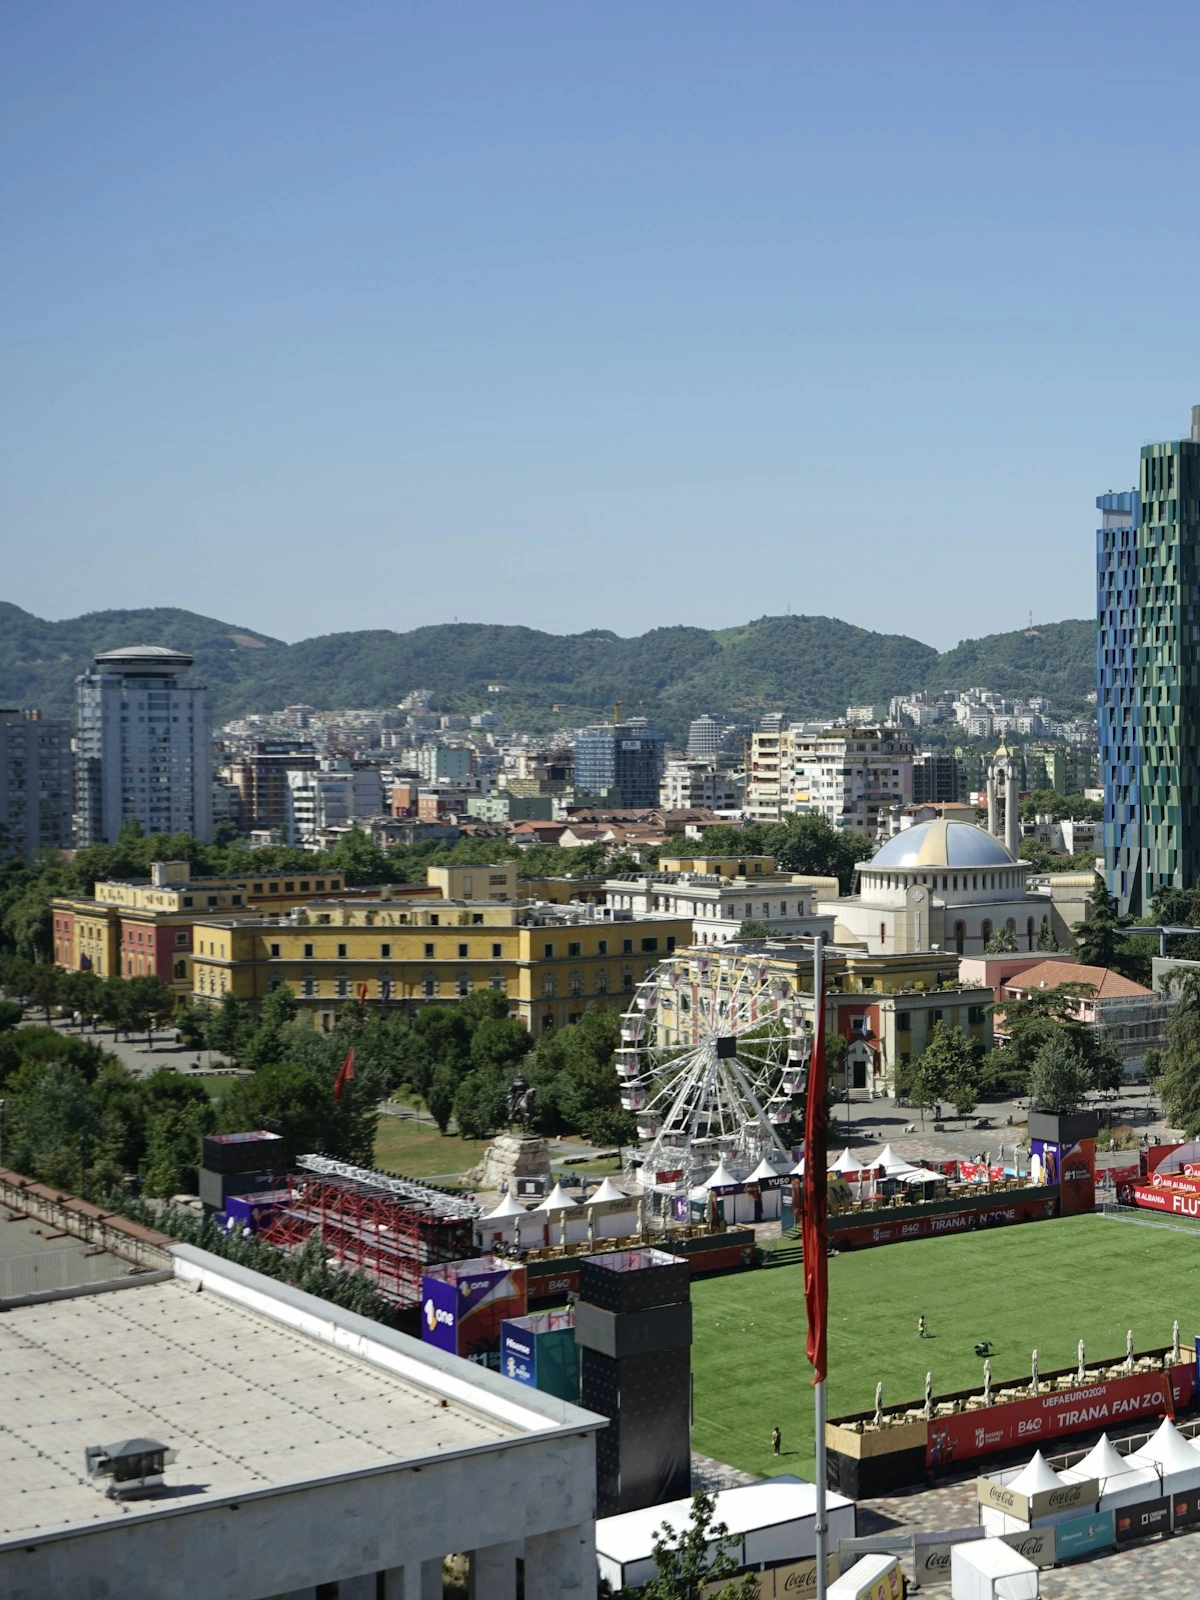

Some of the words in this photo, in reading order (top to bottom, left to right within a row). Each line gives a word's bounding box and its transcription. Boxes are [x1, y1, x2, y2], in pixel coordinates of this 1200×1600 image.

[1064, 1170, 1076, 1181] #1
[1162, 1179, 1171, 1188] AIR
[1171, 1181, 1196, 1192] ALBANIA
[1131, 1191, 1141, 1200] AIR
[1141, 1192, 1165, 1205] ALBANIA
[930, 1216, 966, 1231] TIRANA
[470, 1280, 490, 1290] one
[435, 1308, 454, 1326] one
[505, 1337, 531, 1355] Hisense
[1057, 1405, 1109, 1427] TIRANA
[1111, 1395, 1140, 1415] FAN
[1142, 1387, 1181, 1408] ZOE
